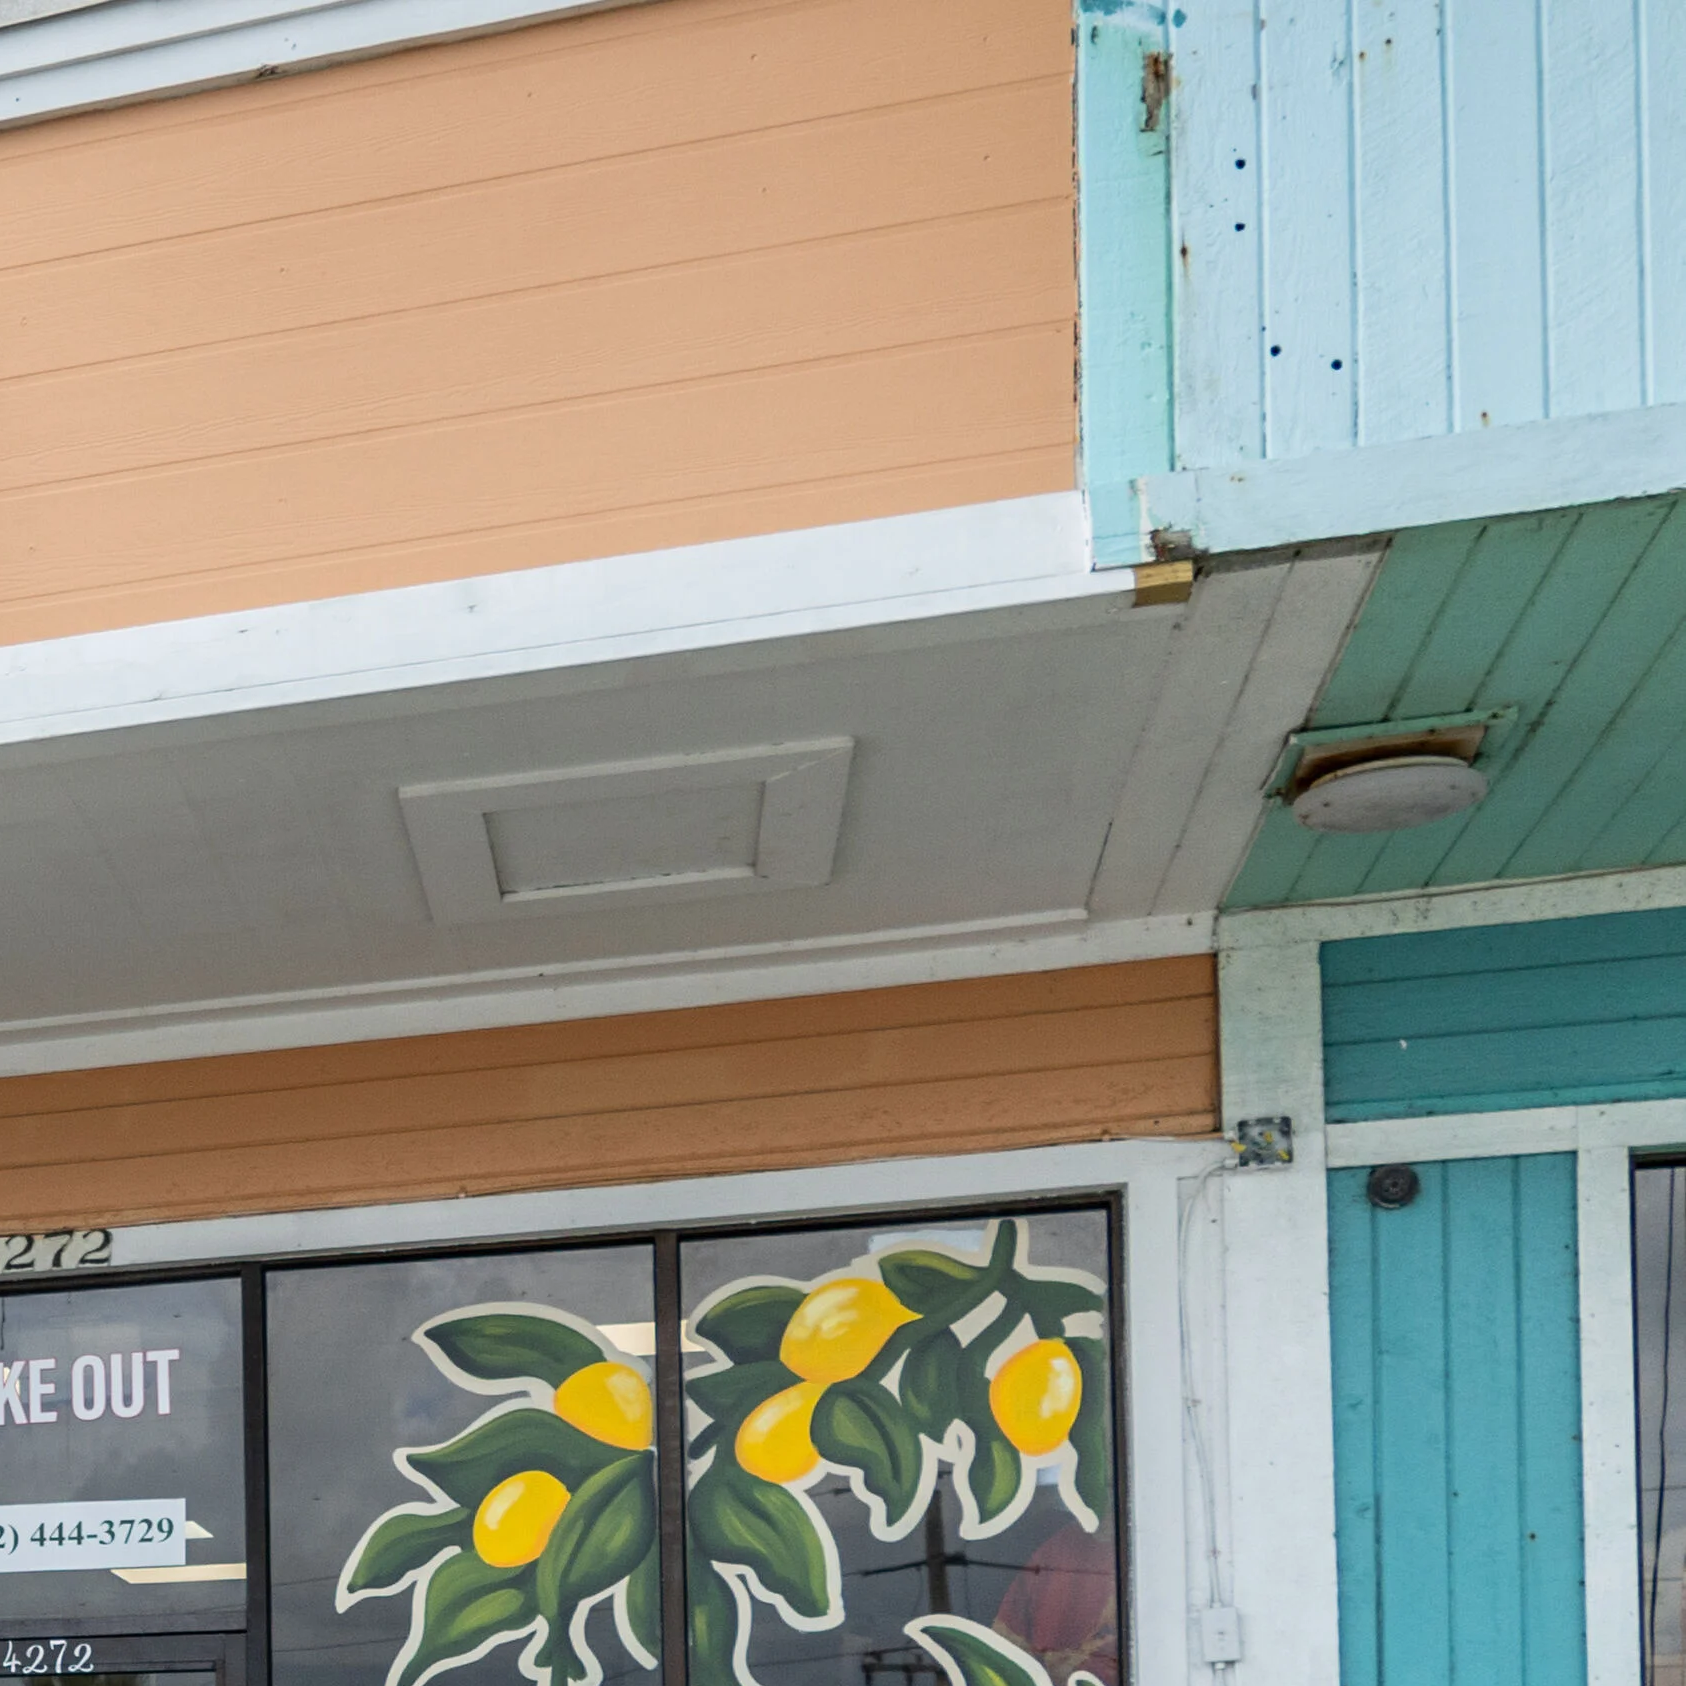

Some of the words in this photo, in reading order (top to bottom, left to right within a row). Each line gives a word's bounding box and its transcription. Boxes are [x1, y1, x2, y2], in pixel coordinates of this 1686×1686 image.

[72, 1349, 180, 1421] OUT
[30, 1517, 174, 1548] 444-3729
[3, 1640, 94, 1674] 4272
